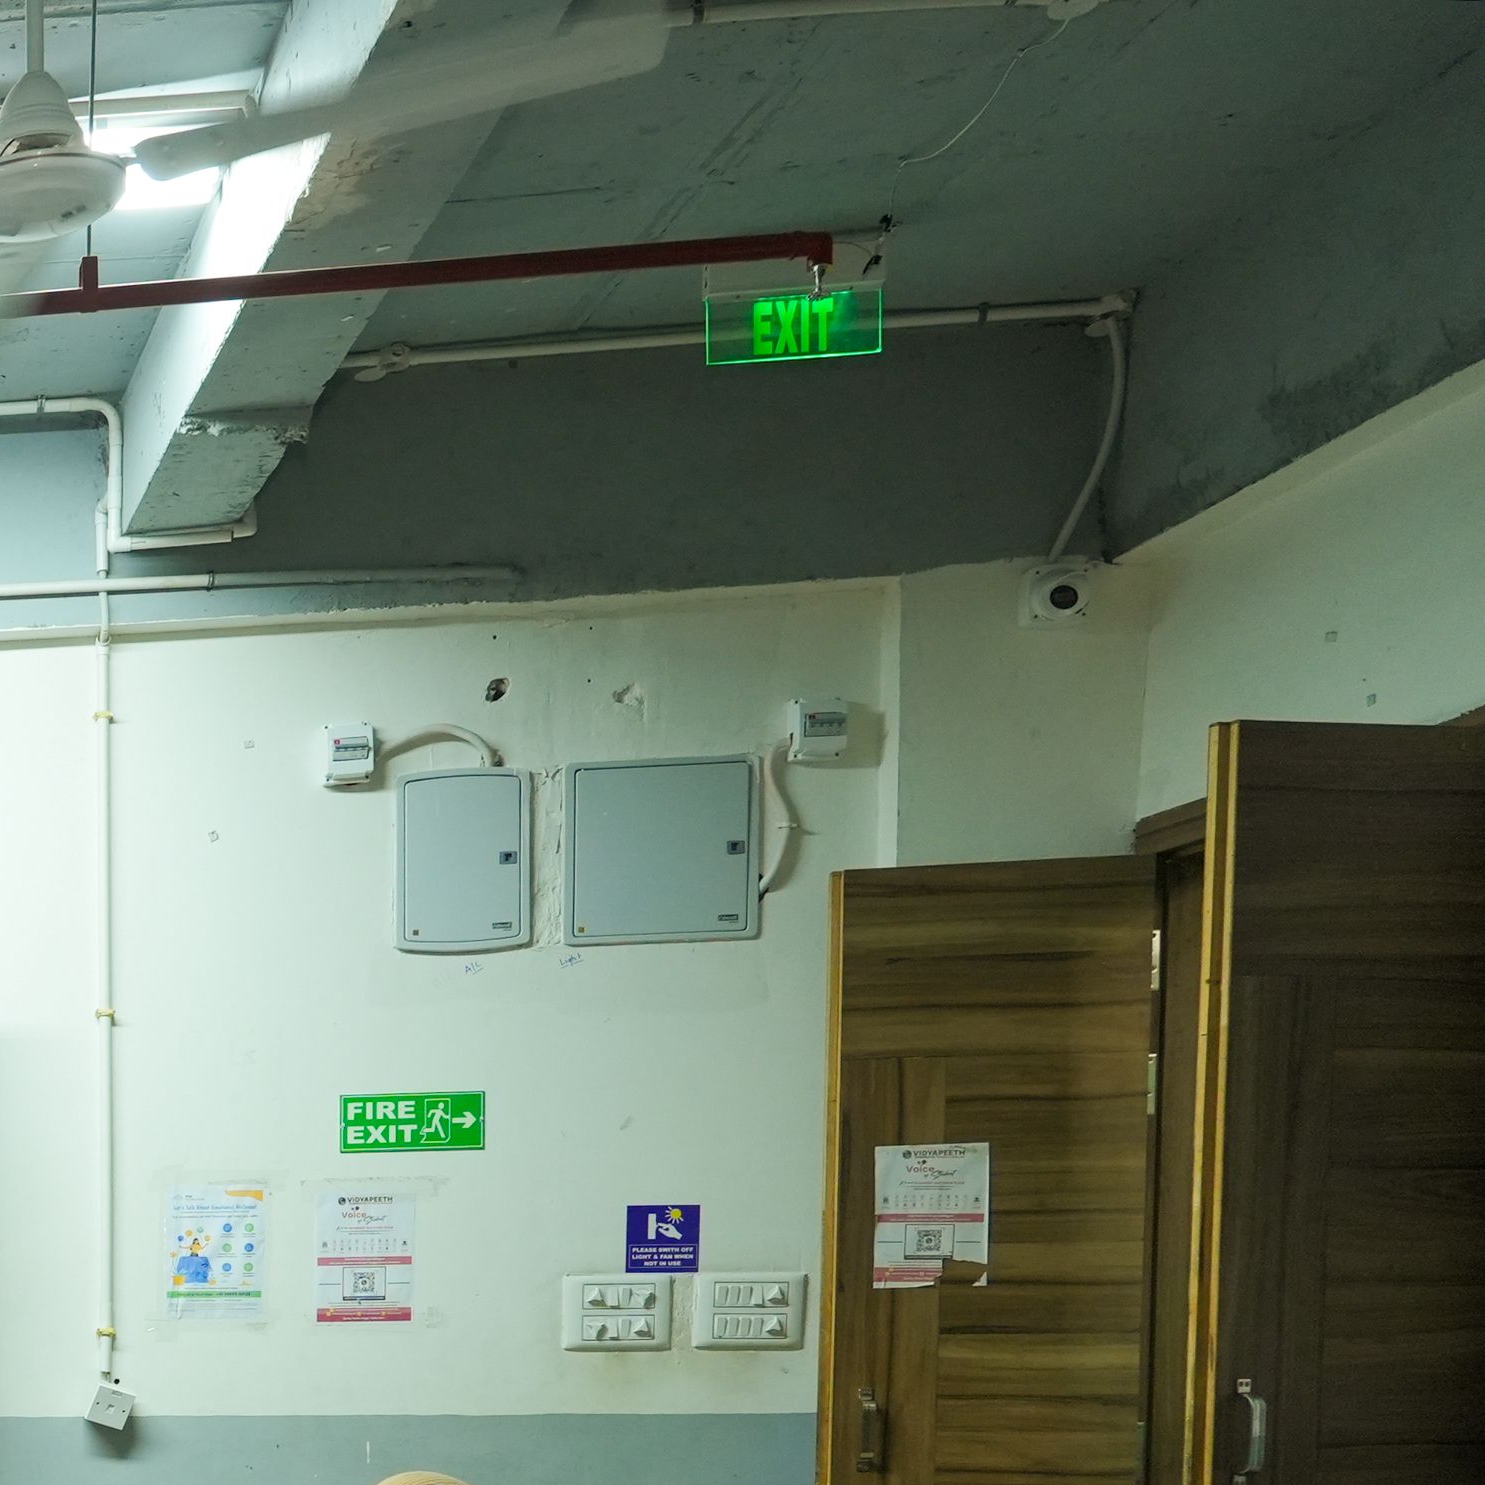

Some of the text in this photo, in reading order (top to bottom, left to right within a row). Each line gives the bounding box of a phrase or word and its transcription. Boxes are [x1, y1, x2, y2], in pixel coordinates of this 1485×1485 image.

[753, 297, 833, 356] EXIT
[347, 1100, 416, 1120] FIRE
[346, 1124, 417, 1144] EXIT
